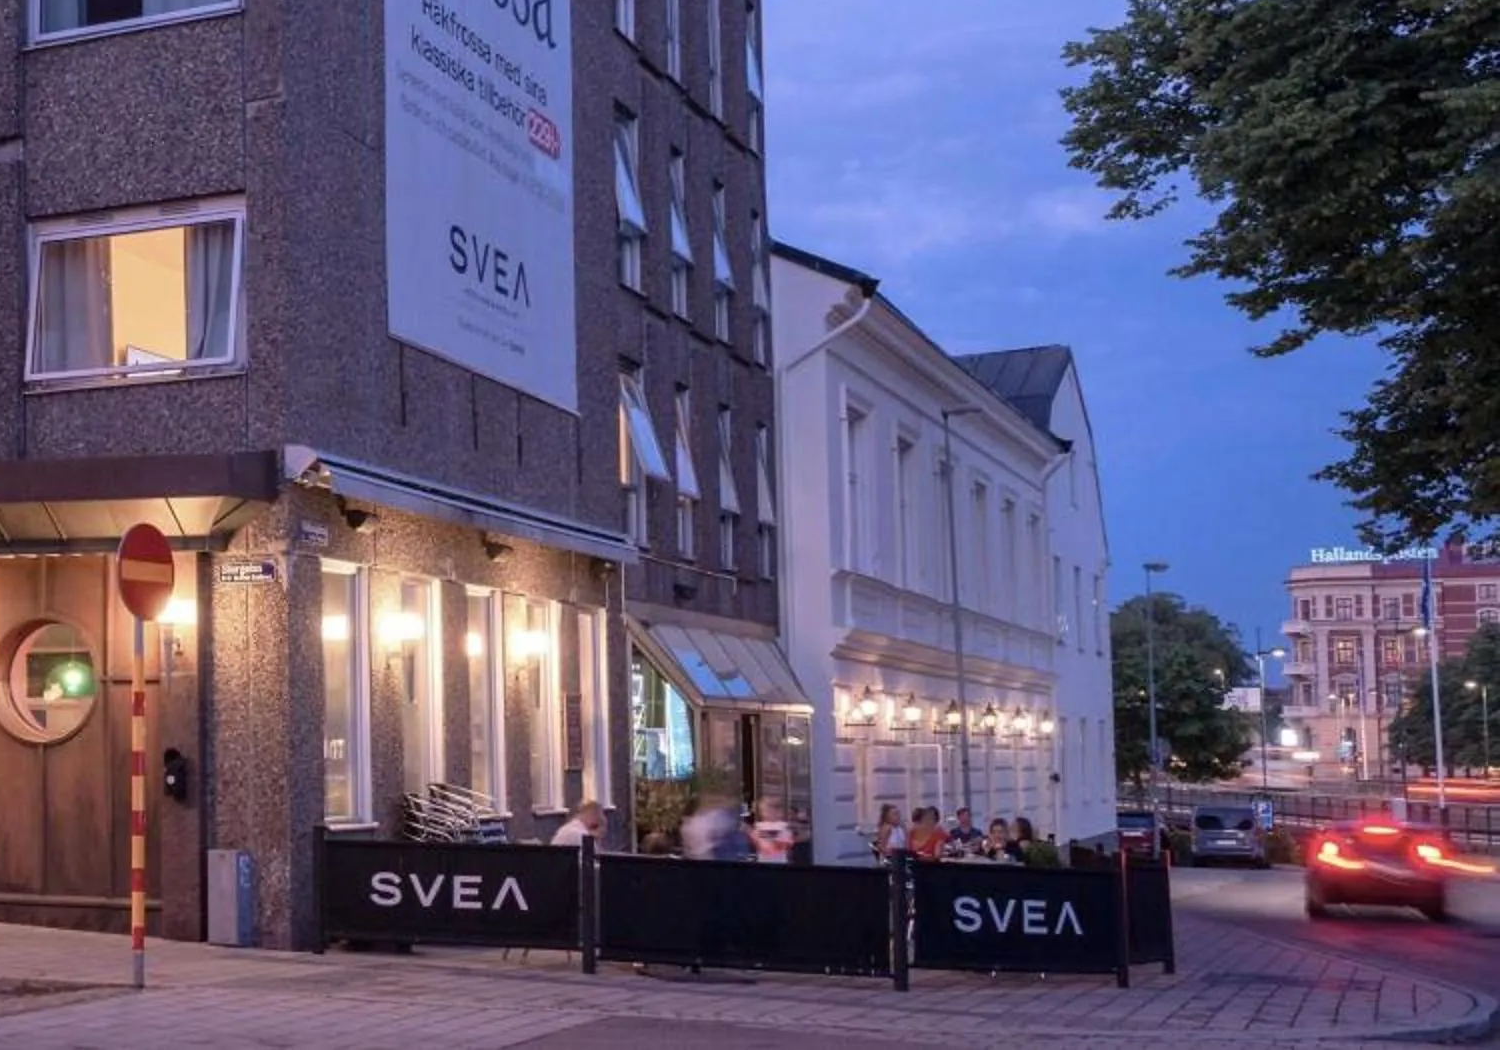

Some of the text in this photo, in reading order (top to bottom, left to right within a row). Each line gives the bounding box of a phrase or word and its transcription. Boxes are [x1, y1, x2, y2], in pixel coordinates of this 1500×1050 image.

[411, 23, 475, 92] klassiska
[495, 52, 521, 87] med
[449, 224, 532, 308] SVEA
[370, 871, 529, 911] SVEA
[953, 896, 1083, 935] SVEA
